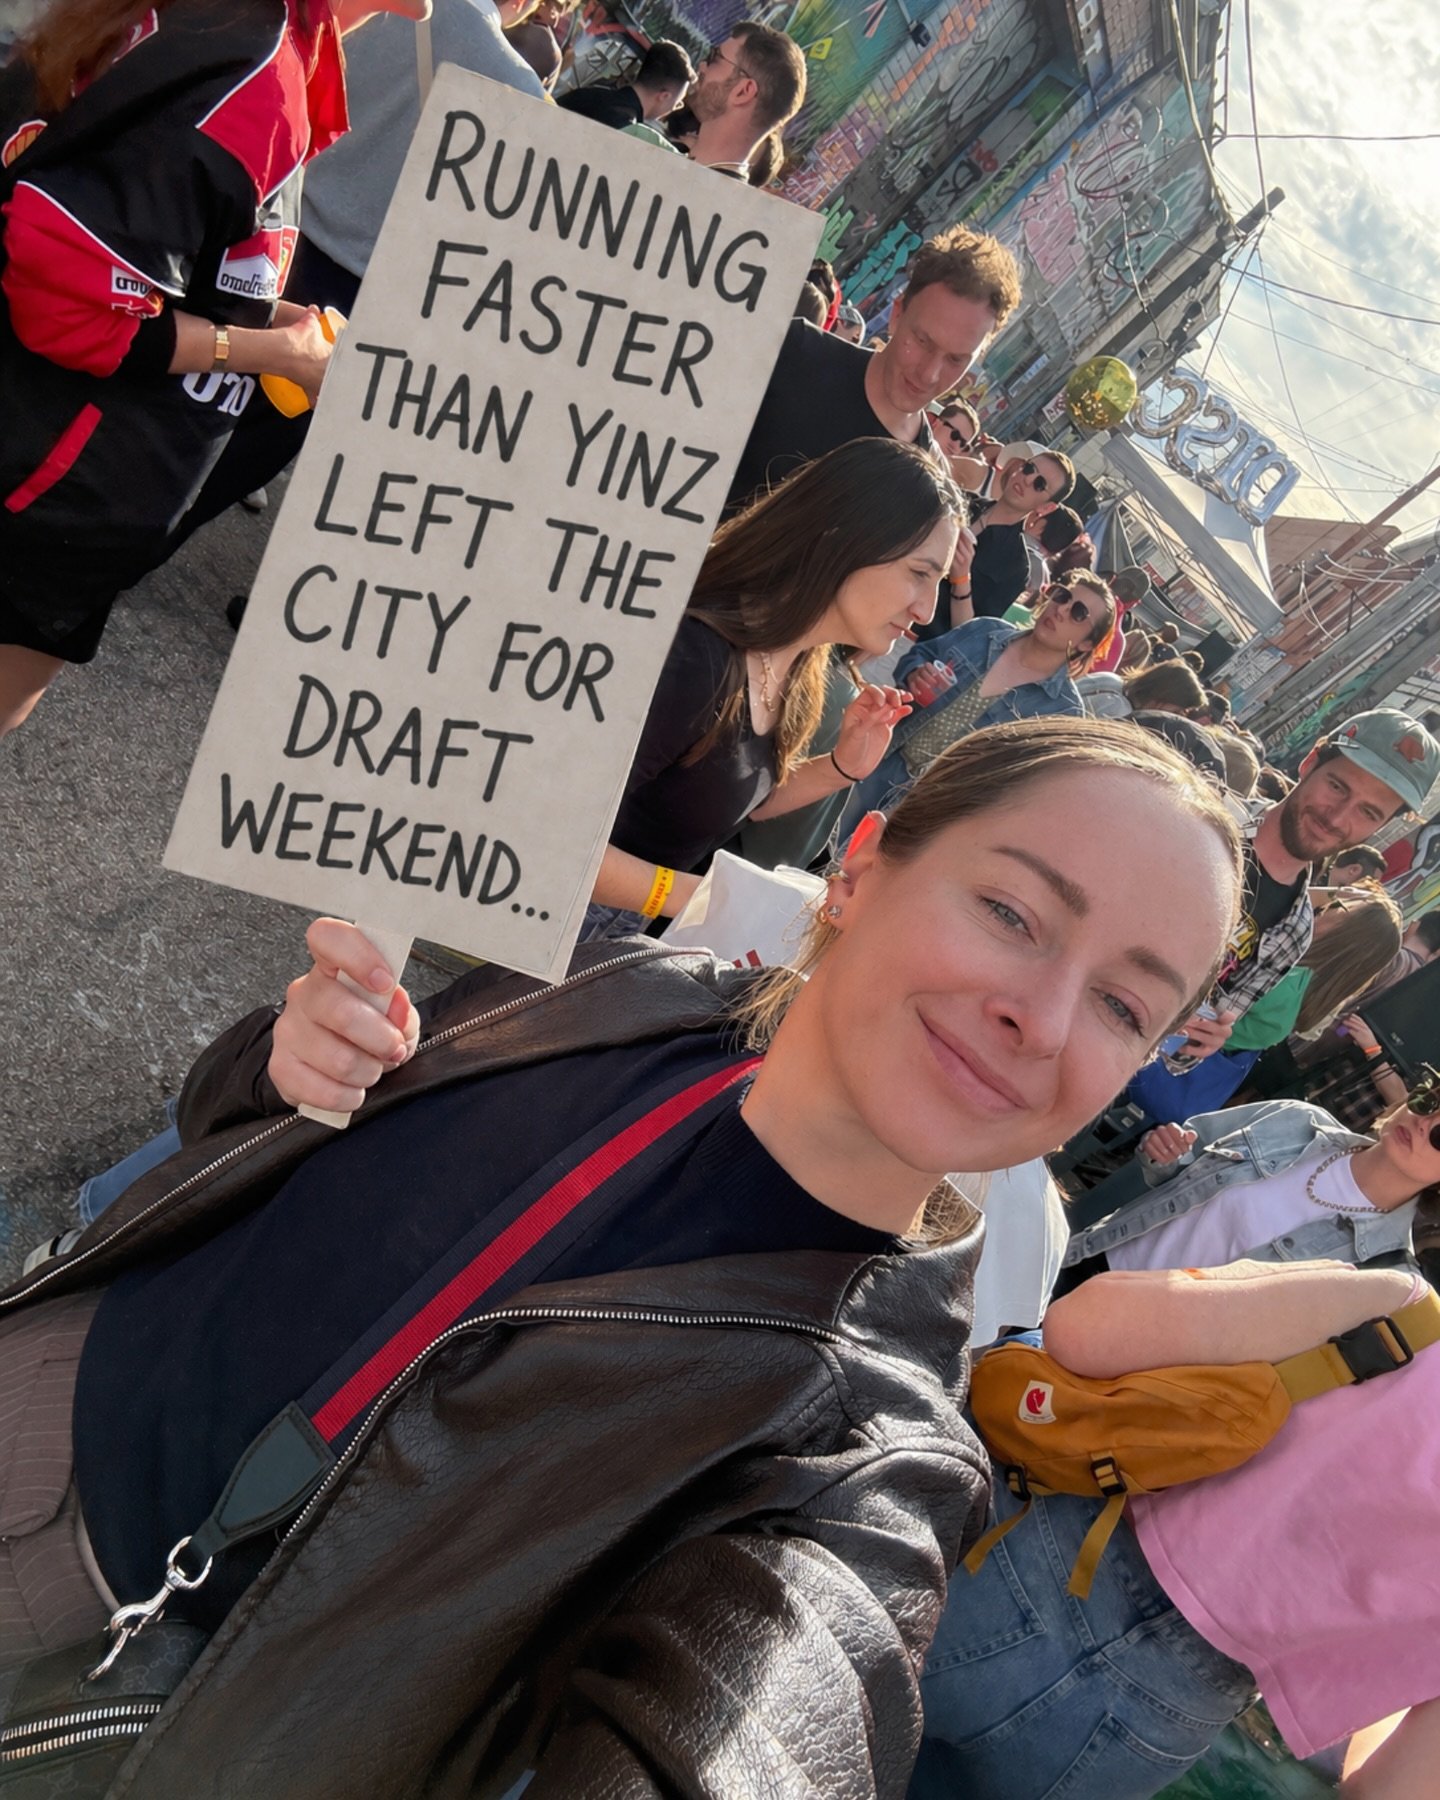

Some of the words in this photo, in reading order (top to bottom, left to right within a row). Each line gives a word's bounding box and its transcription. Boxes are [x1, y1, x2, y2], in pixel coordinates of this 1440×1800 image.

[425, 110, 769, 313] RUNNING
[420, 239, 714, 409] FASTER
[355, 342, 534, 463] THAN
[566, 402, 720, 524] YINZ
[313, 453, 515, 570] LEFT
[545, 517, 676, 619] THE
[283, 564, 472, 674] CITY
[488, 621, 614, 723] FOR
[282, 674, 534, 803] DRAFT
[220, 772, 550, 921] WEEKEND...
